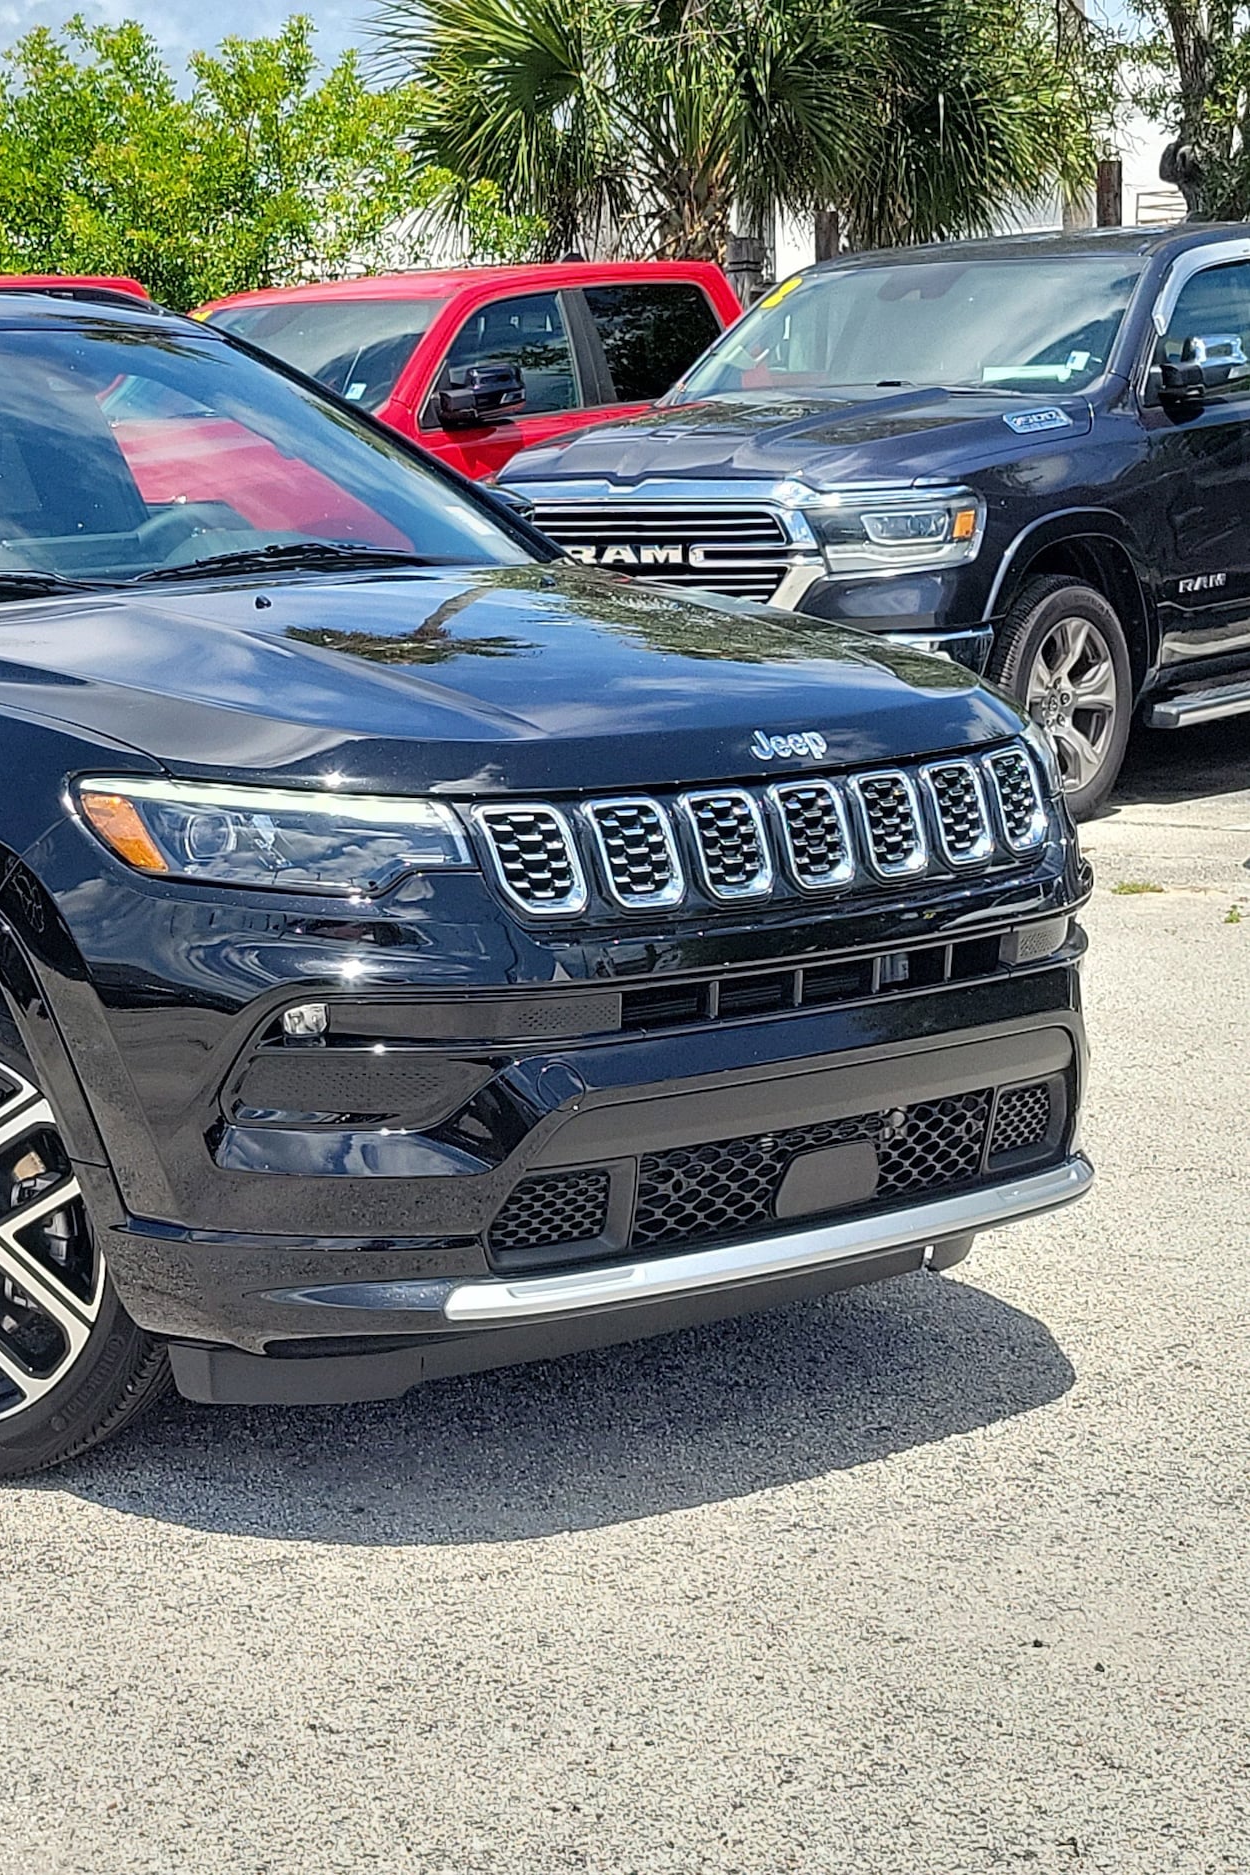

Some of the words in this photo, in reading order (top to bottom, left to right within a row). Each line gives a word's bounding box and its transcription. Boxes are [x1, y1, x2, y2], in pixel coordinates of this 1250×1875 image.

[561, 543, 683, 565] RAM
[1178, 572, 1227, 594] RAM
[749, 729, 828, 761] Jeep
